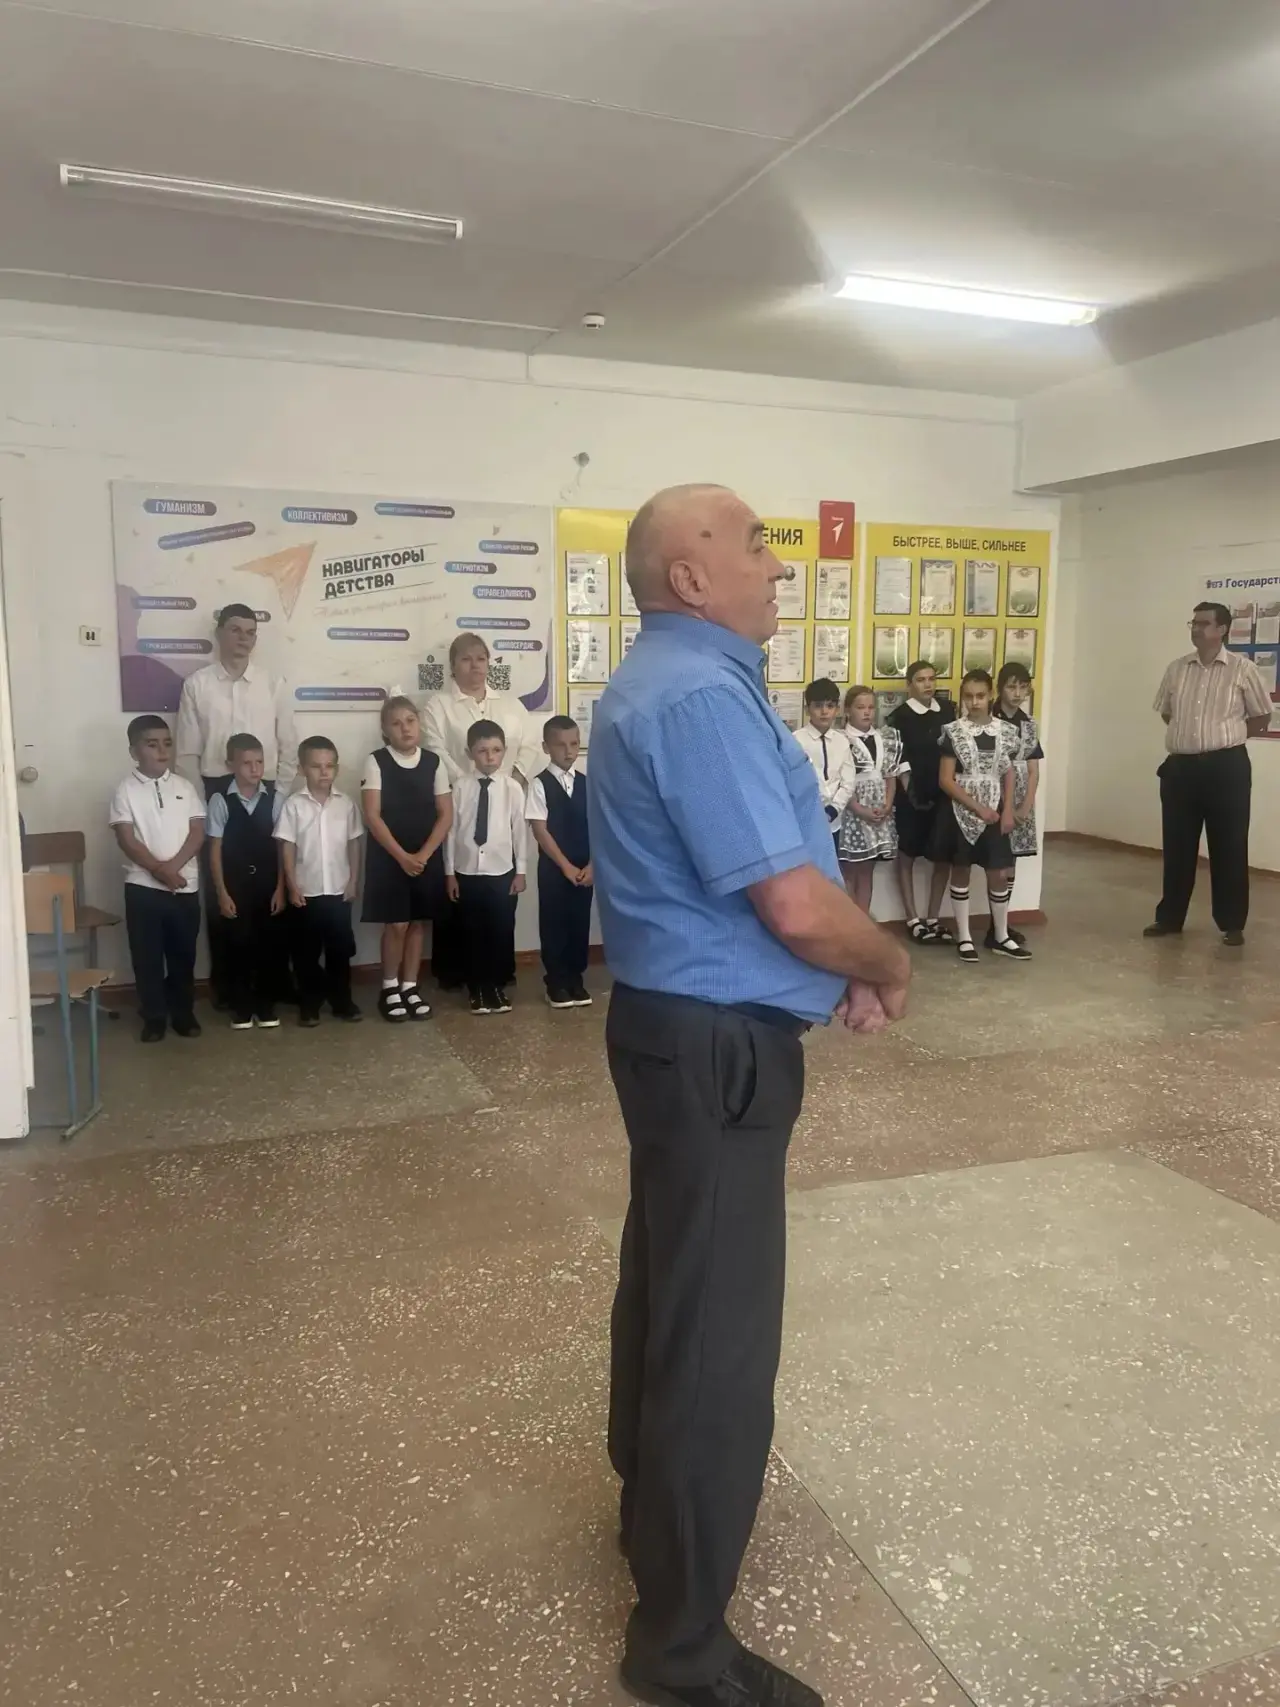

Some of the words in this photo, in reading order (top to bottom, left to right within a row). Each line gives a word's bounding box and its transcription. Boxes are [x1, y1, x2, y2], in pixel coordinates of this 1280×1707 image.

[155, 501, 206, 514] ГУМАНИЗМ
[287, 509, 348, 522] КОЛЛЕКТИВИЗМ
[892, 536, 943, 550] БЫСТРЕЕ,
[945, 538, 980, 551] ВЫШЕ,
[982, 540, 1027, 552] СИЛЬНЕЕ
[322, 548, 425, 578] НАВИГАТОРЫ
[451, 563, 489, 573] ПАТРИОТИЗМ
[324, 572, 394, 599] ДЕТСТВА
[477, 587, 532, 599] СПРАВЕДЛИВОСТЬ
